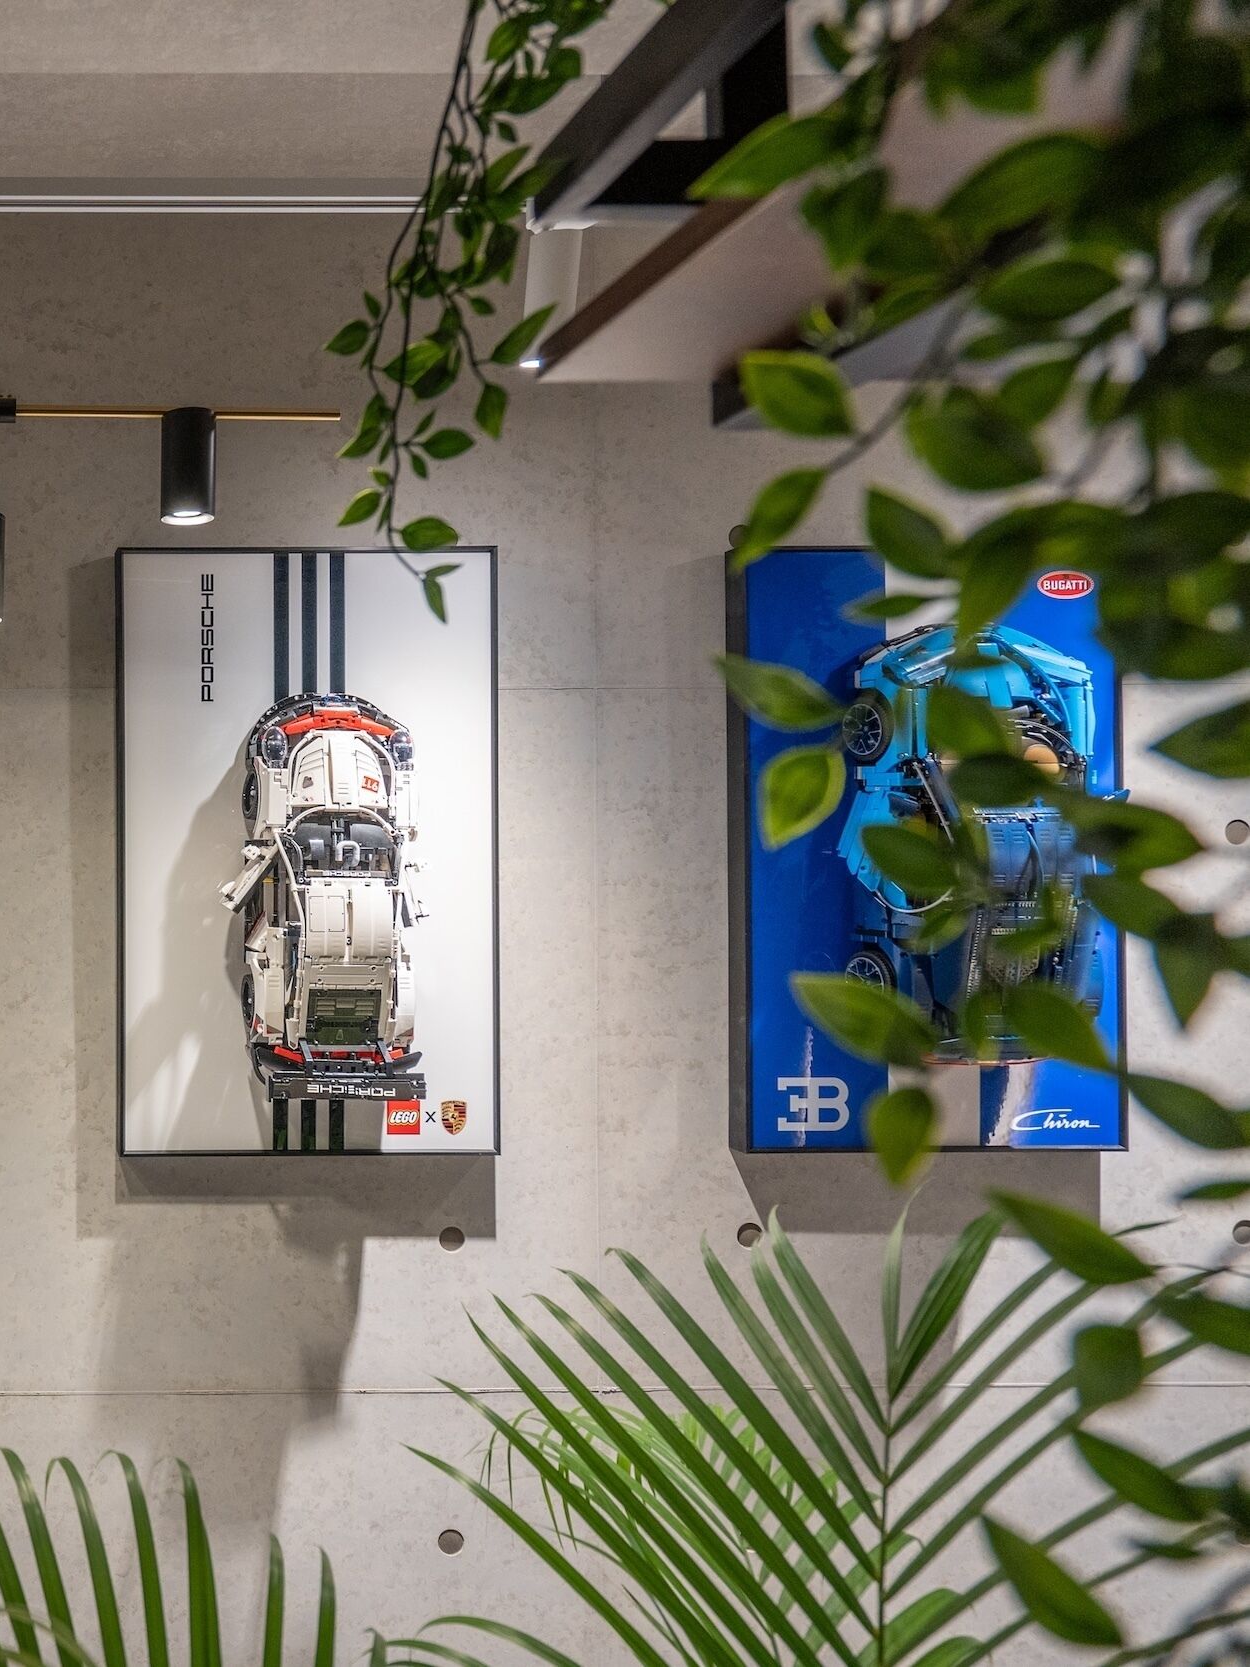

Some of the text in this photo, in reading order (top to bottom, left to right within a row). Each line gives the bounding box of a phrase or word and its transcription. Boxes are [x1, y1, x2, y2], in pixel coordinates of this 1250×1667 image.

[1042, 579, 1089, 591] BUGATTI
[200, 573, 215, 703] PORSCHE
[389, 1110, 419, 1125] LEGO
[1009, 1108, 1101, 1131] Chiron
